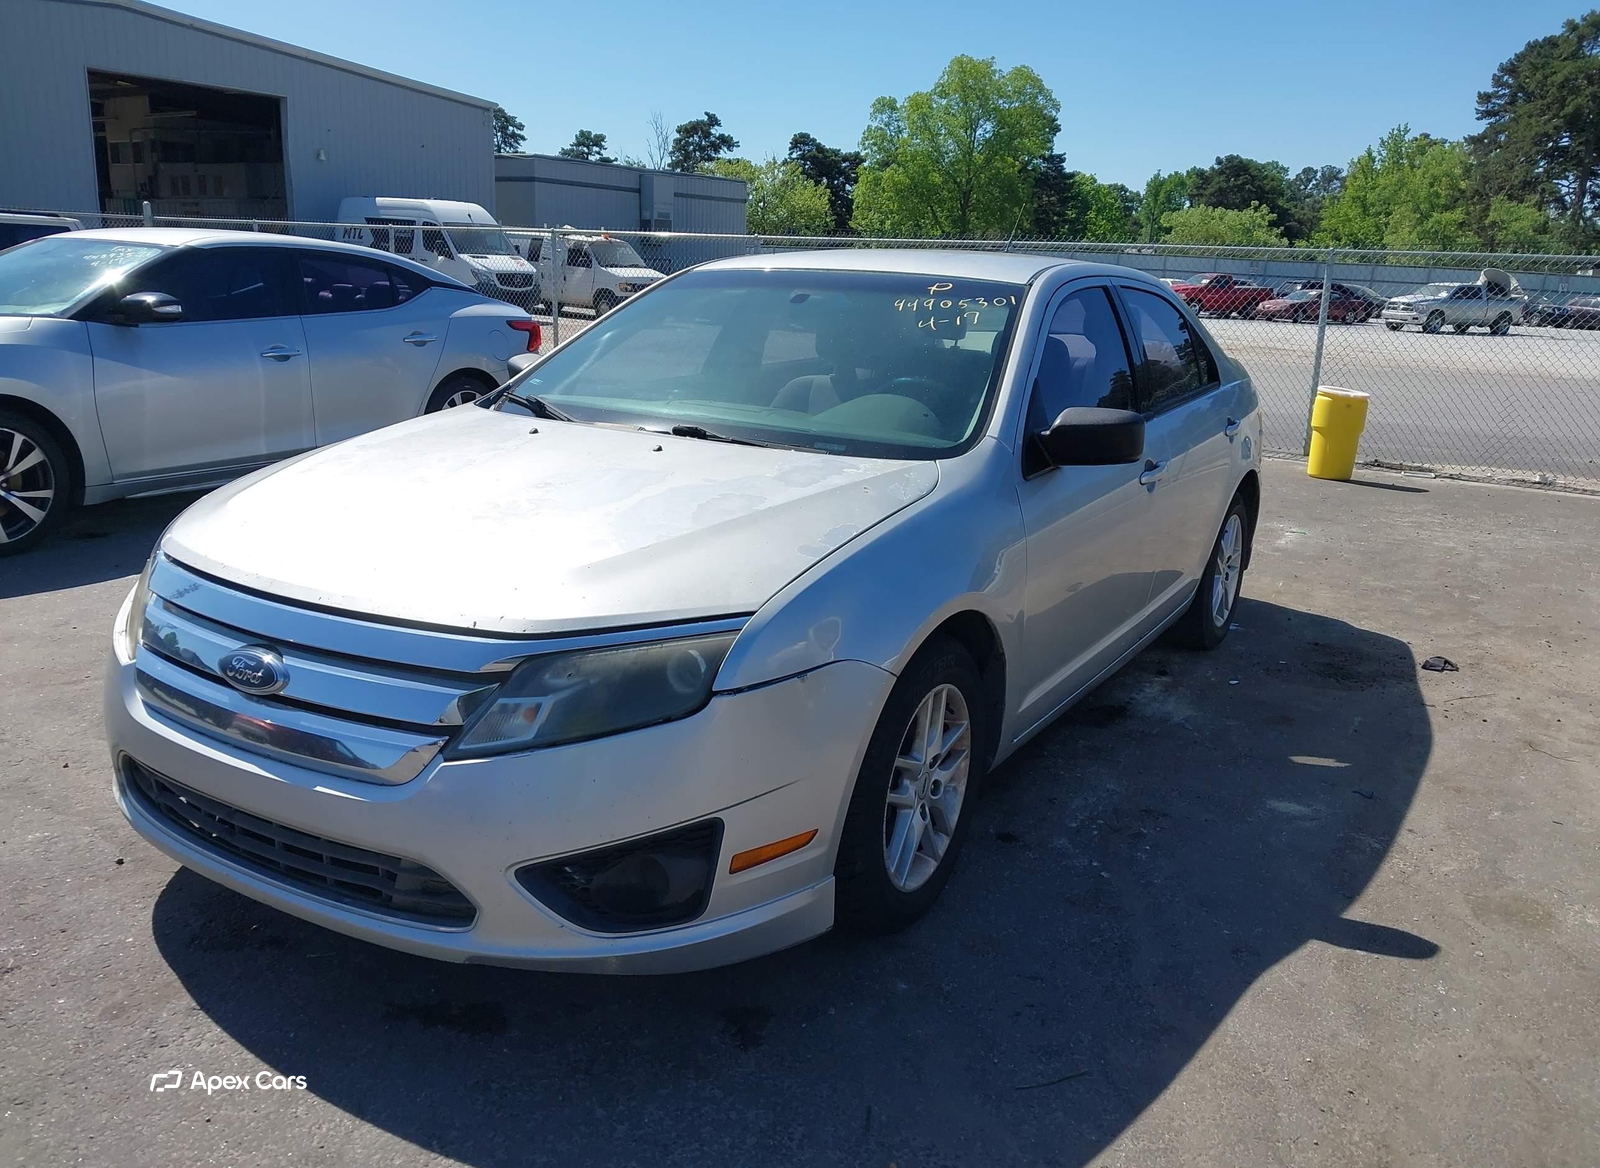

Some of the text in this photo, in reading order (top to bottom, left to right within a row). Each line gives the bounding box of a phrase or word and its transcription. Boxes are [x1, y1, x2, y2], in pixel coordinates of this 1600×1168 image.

[894, 295, 1017, 312] 44905301
[918, 311, 980, 331] 4-17
[226, 656, 265, 684] Ford
